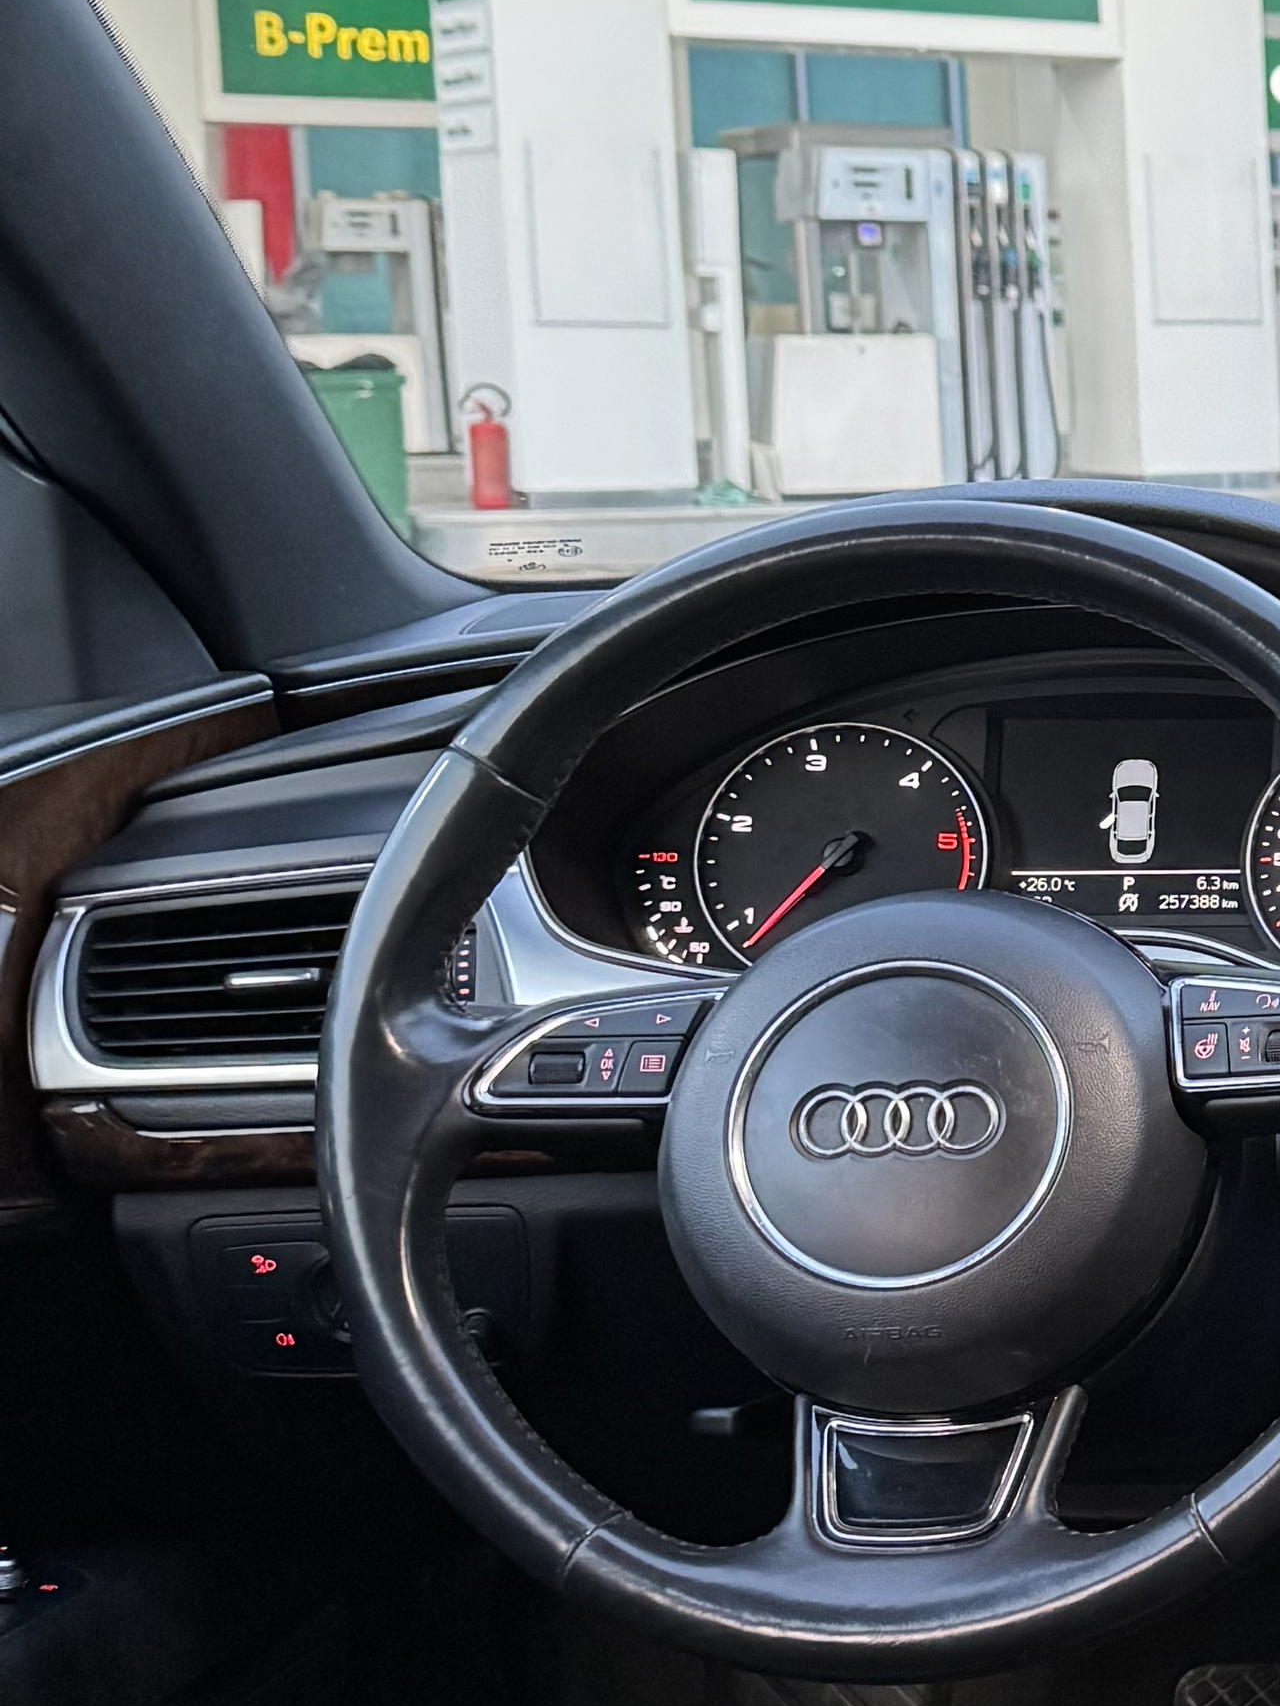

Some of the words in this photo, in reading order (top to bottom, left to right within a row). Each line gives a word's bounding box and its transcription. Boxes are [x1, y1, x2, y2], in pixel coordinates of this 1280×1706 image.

[254, 10, 430, 63] B-Prem
[804, 754, 828, 772] 3
[899, 771, 921, 790] 4
[730, 814, 753, 833] 2
[936, 831, 959, 850] 5
[1019, 877, 1062, 892] +26.0
[1123, 877, 1135, 891] P
[1196, 876, 1220, 891] 6.3
[1222, 880, 1240, 891] km
[1158, 894, 1220, 909] 257388
[1221, 898, 1239, 909] km
[743, 906, 755, 925] 1
[1200, 1002, 1221, 1012] NAV
[600, 1058, 614, 1069] OK
